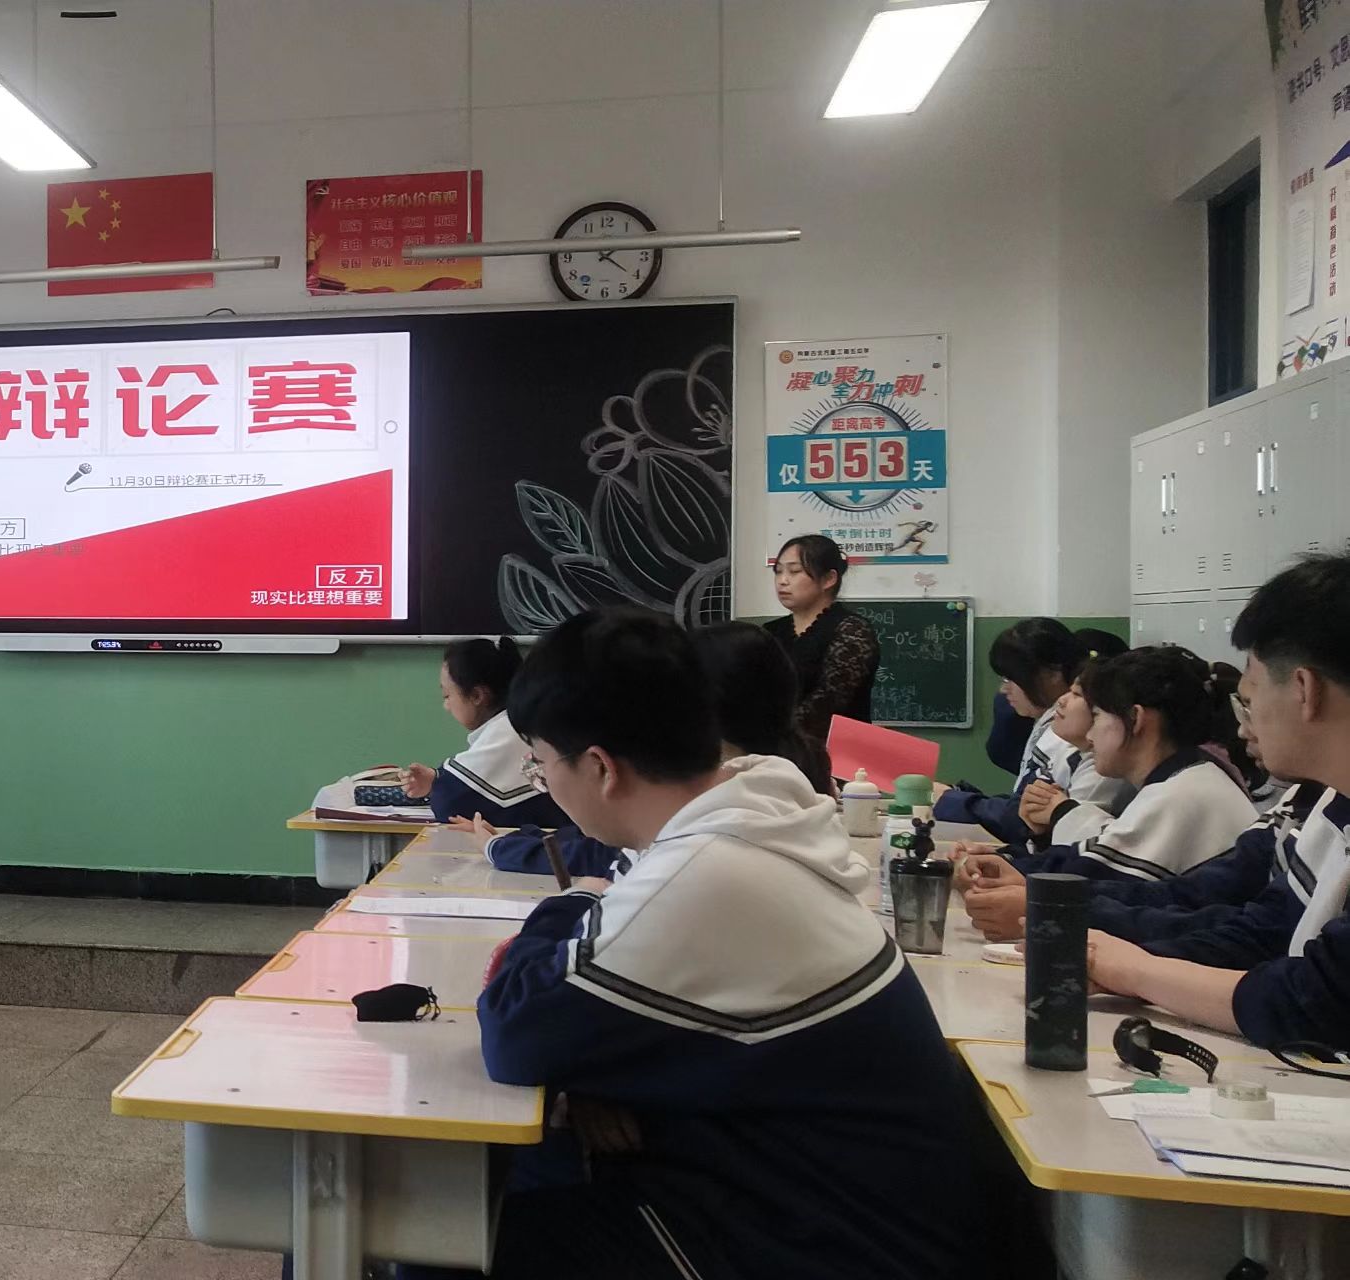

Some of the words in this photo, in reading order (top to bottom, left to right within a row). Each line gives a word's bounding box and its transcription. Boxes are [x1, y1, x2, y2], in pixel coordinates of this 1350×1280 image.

[330, 190, 458, 210] 社会主义核心价值观
[584, 223, 593, 233] 11
[601, 216, 614, 228] 12
[639, 251, 649, 262] 3
[569, 269, 578, 280] 8
[632, 269, 640, 280] 4
[600, 287, 609, 298] 6
[618, 283, 627, 293] 5
[786, 365, 876, 391] 凝心聚力
[831, 373, 925, 401] 全力冲刺
[832, 417, 886, 431] 距离高考
[779, 463, 801, 485] 仅
[809, 440, 905, 480] 553
[913, 460, 934, 482] 天
[109, 473, 266, 486] 11月30日辩论赛正式开场
[819, 528, 892, 539] 高考倒计时
[329, 568, 375, 585] 反方
[250, 590, 383, 606] 现实比理想重要
